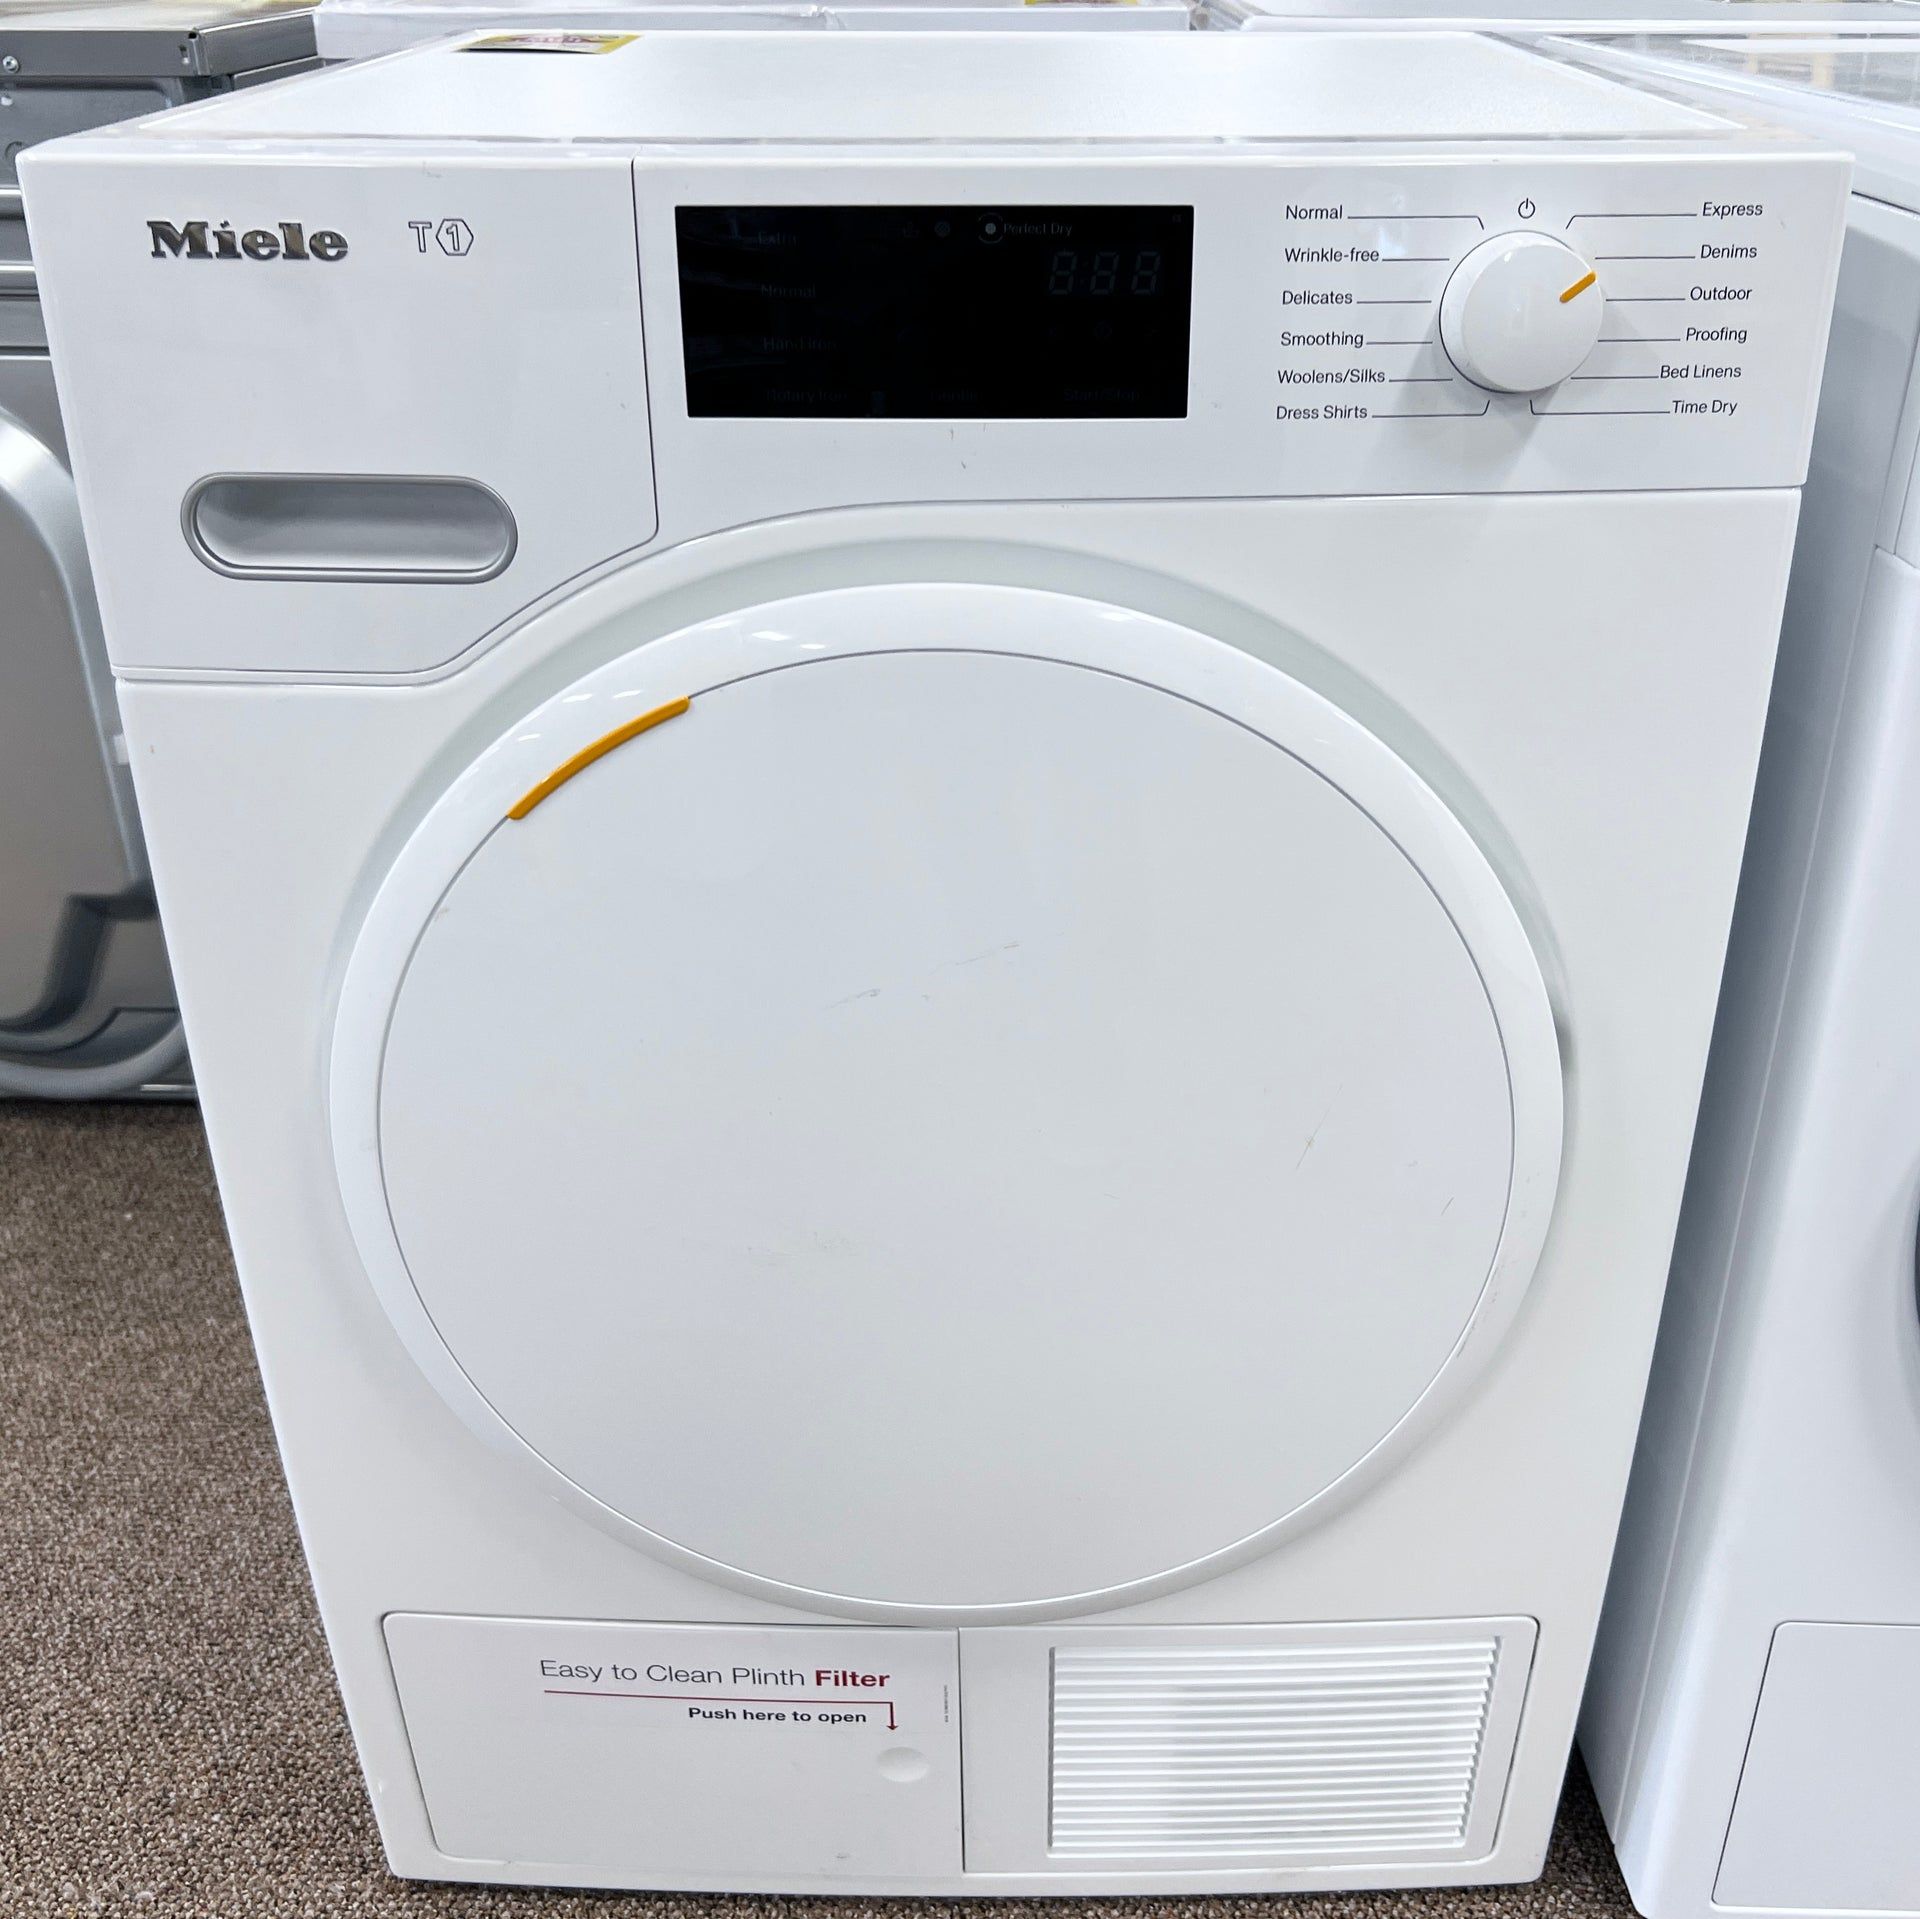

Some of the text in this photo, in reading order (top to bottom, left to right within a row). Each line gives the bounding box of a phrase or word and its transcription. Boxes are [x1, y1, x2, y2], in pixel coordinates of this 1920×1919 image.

[1285, 204, 1343, 220] Normal
[1702, 202, 1763, 219] Express
[1052, 222, 1073, 237] Dry
[146, 220, 349, 262] Miele
[1284, 247, 1380, 262] Wrinkle-free
[1700, 244, 1758, 259] Denims
[1282, 290, 1353, 305] Delicates
[1690, 286, 1752, 301] Outdoor
[1280, 331, 1364, 349] Smoothing
[1686, 327, 1747, 344] Proofing
[1277, 368, 1386, 384] Woolens/Silks
[1660, 364, 1742, 379] Bed Linens
[1276, 405, 1368, 420] Dress Shirts
[1672, 400, 1738, 416] Time Dry
[540, 1660, 890, 1687] Easy to Clean Plinth Filter
[688, 1707, 867, 1724] Push here to open
